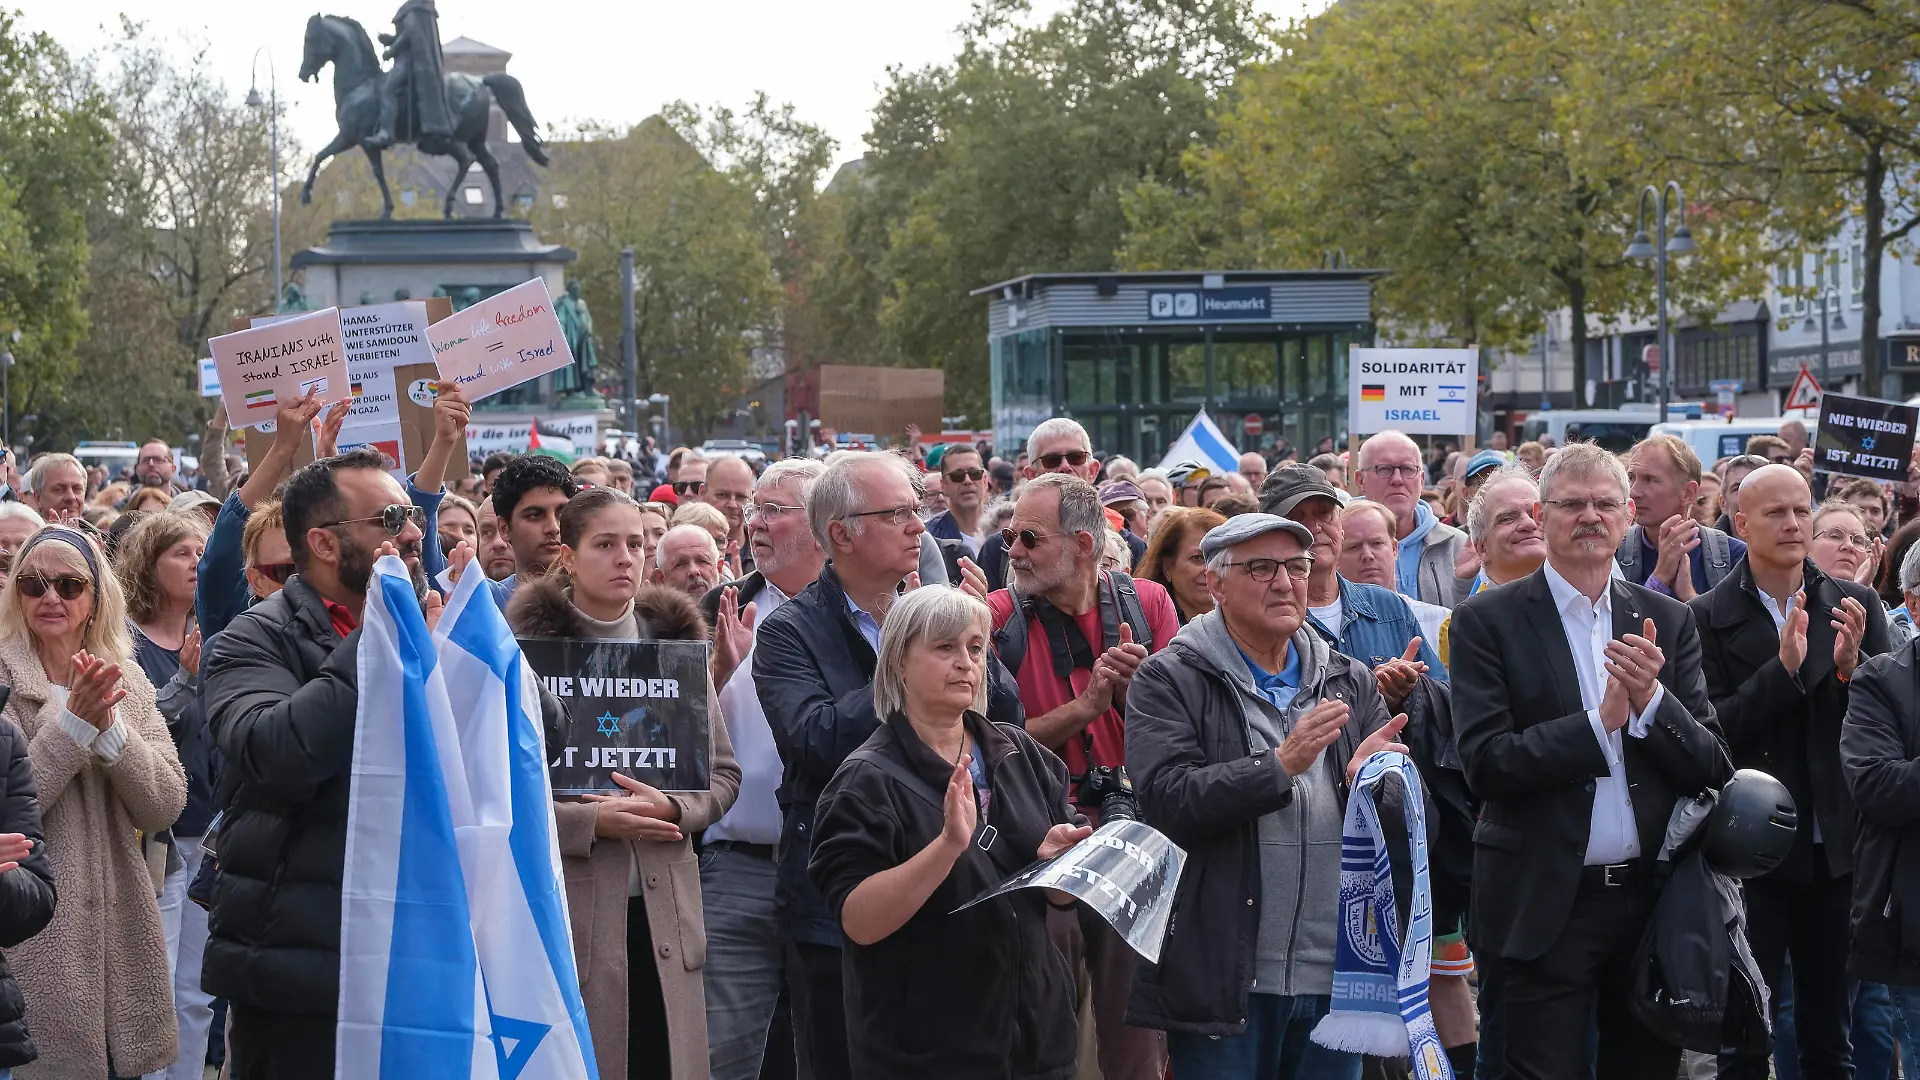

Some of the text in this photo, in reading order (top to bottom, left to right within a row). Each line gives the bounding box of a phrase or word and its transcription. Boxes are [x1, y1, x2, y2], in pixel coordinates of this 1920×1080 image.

[1204, 297, 1266, 310] Heumarkt
[343, 314, 381, 326] HAMAS-
[344, 323, 414, 338] UNTERSTÜTZER
[236, 332, 335, 366] IRANIANS with
[346, 335, 418, 350] WIE SAMIDOUN
[347, 349, 400, 362] VERBIETEN!
[517, 340, 555, 363] Israel
[290, 350, 338, 375] ISRAEL
[1361, 360, 1467, 374] SOLIDARITÄT
[363, 394, 390, 403] DURCH
[1399, 386, 1427, 396] MIT
[358, 406, 380, 414] GAZA
[1385, 409, 1441, 421] ISRAEL
[1828, 412, 1908, 434] NIE WIEDER
[482, 428, 504, 439] die
[1826, 448, 1899, 470] IST JETZT!
[579, 677, 680, 698] WIEDER
[584, 746, 677, 769] JETZT!
[1348, 981, 1399, 1004] ISRAE
